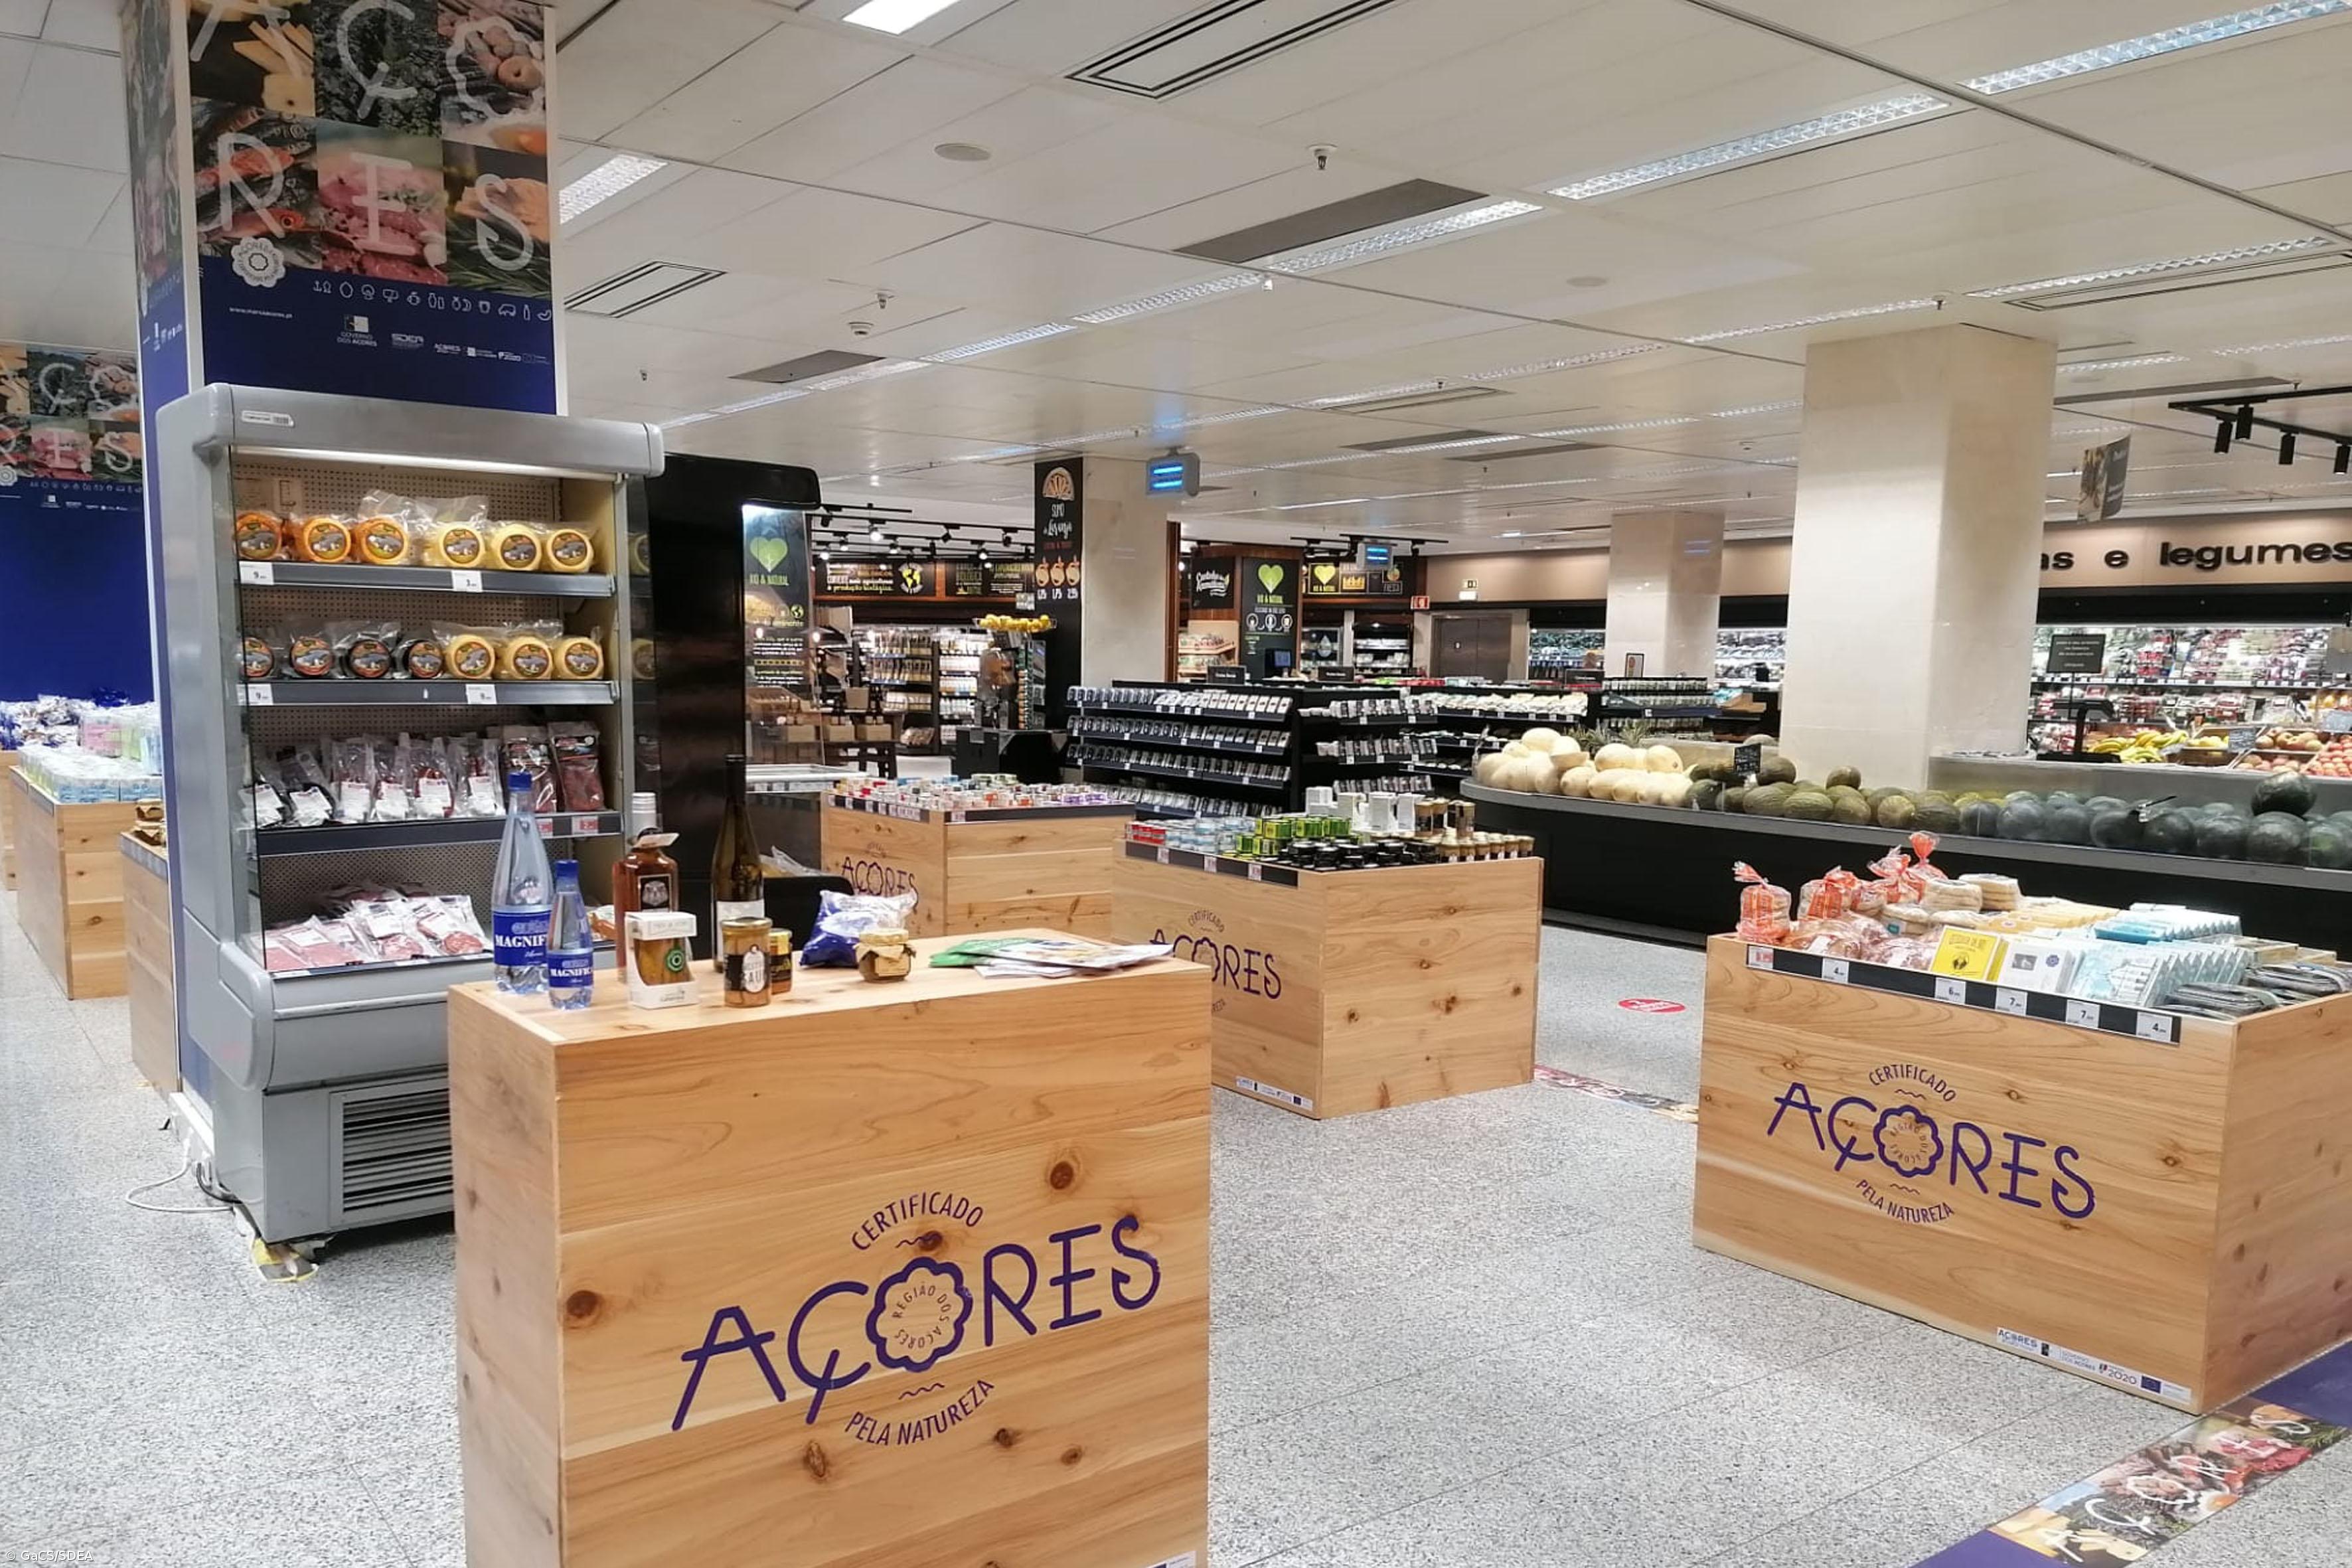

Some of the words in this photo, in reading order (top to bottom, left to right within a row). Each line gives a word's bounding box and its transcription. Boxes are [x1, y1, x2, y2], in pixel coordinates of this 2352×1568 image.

[2104, 549, 2129, 569] e
[2159, 541, 2352, 571] legumes
[1869, 1063, 1956, 1103] CERTIFICADO
[1767, 1082, 2096, 1219] AÇORES
[850, 1191, 985, 1251] CERTIFICADO
[1856, 1179, 1885, 1210] PELA
[1886, 1202, 1955, 1224] NATUREZA
[672, 1215, 1162, 1431] AÇORES
[892, 1281, 936, 1319] REGIÃO
[937, 1293, 952, 1322] DOS
[2108, 1368, 2138, 1385] 2020
[844, 1411, 891, 1447] PELA
[898, 1379, 996, 1446] NATUREZA
